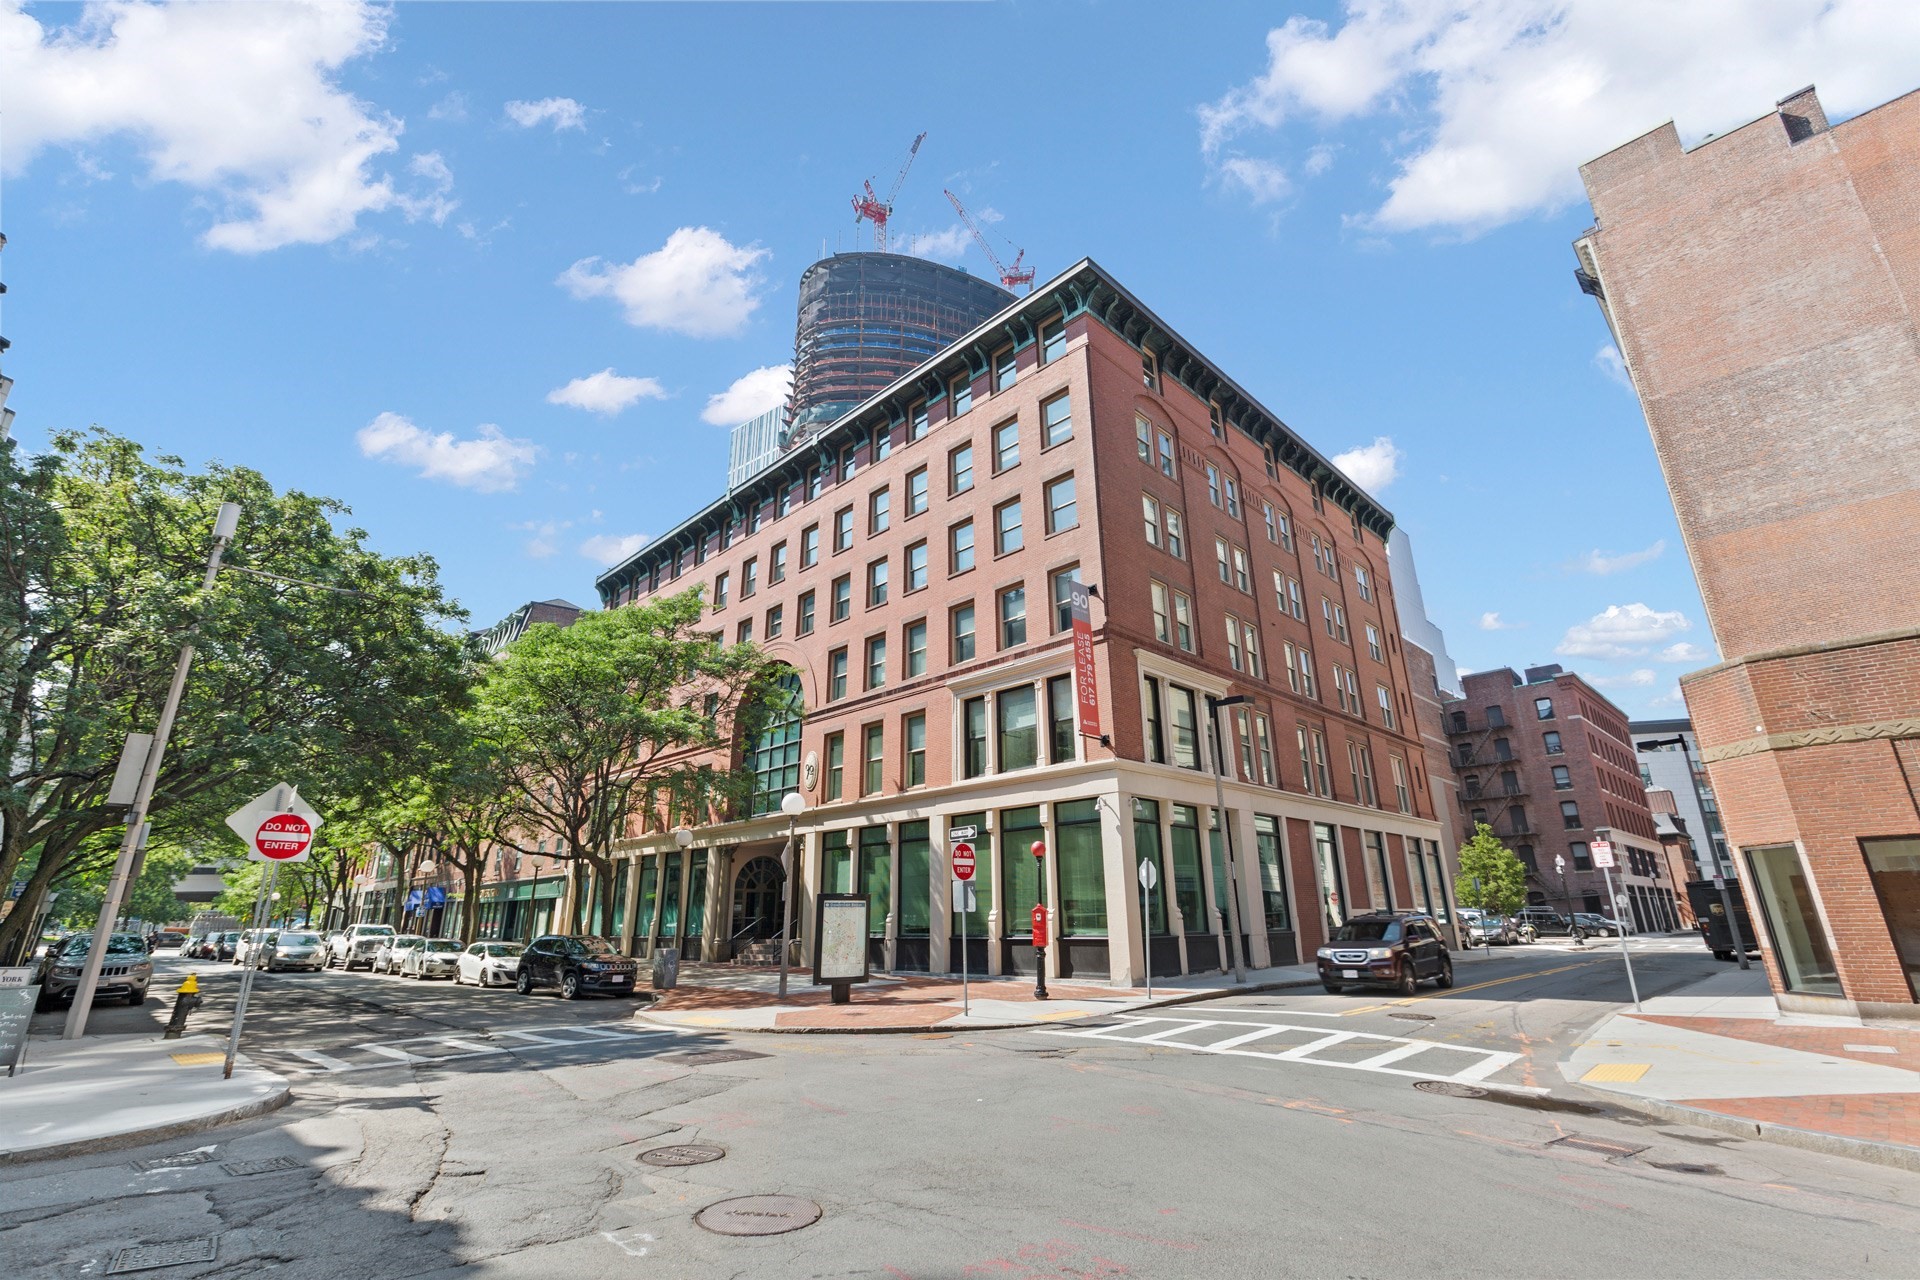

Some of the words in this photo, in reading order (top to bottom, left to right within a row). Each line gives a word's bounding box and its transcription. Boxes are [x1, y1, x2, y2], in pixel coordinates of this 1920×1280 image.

[1072, 591, 1088, 609] 90
[1077, 631, 1087, 673] LEASE
[1084, 633, 1092, 661] 4555
[1086, 665, 1094, 684] 279
[1080, 676, 1088, 704] FOR
[1088, 687, 1096, 706] 617
[265, 822, 282, 831] DO
[284, 823, 308, 832] NOT
[263, 841, 299, 850] ENTER
